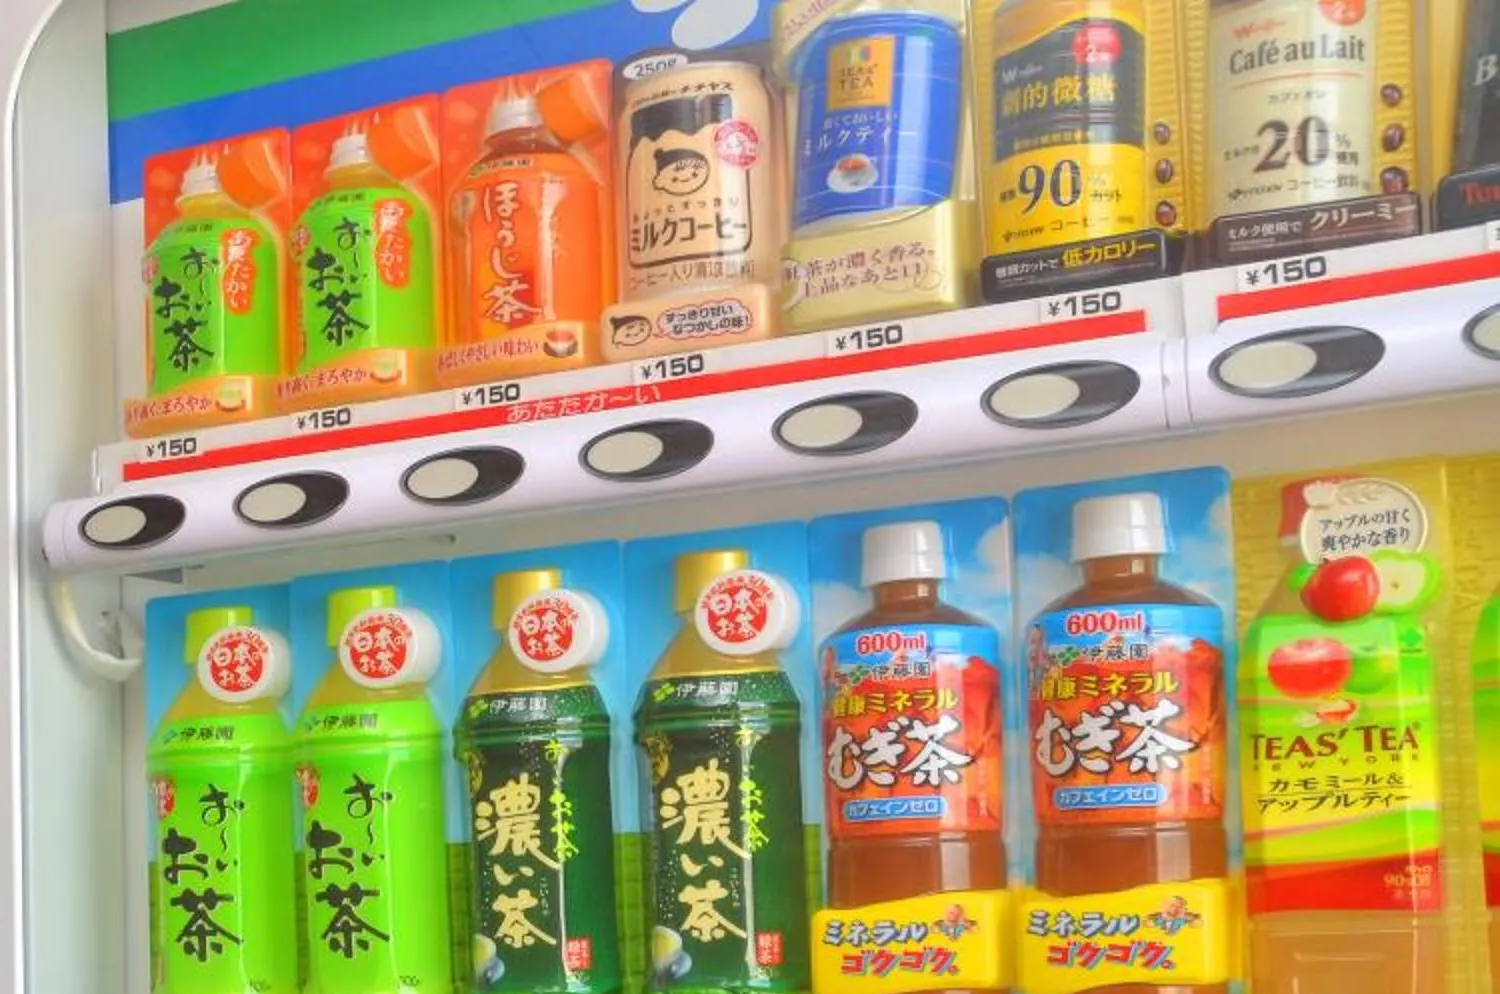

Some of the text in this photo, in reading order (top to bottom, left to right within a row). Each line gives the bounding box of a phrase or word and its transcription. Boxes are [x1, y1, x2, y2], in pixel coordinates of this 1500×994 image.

[1228, 33, 1366, 76] Café au Lait
[1253, 116, 1331, 175] 20
[1017, 158, 1082, 215] 90
[631, 211, 748, 252] ミルクコーヒー
[1310, 202, 1417, 232] クリーミー
[483, 179, 543, 324] ほうじ茶
[1061, 238, 1157, 269] 低カロリー
[1245, 256, 1328, 287] ¥150
[306, 246, 370, 347] お茶
[1048, 291, 1122, 317] ¥150
[154, 275, 215, 373] お茶
[835, 323, 904, 351] ¥150
[641, 354, 705, 380] ¥150
[462, 384, 522, 406] ¥150
[297, 408, 352, 430] ¥150
[146, 437, 198, 458] ¥150
[1318, 507, 1411, 531] アップルの甘く
[1320, 529, 1411, 551] 爽やかな香り
[1066, 610, 1144, 636] 600ml
[855, 630, 925, 656] 600ml
[1041, 671, 1180, 701] 健康ミネラル
[833, 686, 959, 719] 健康ミネラル
[827, 714, 973, 791] むぎ茶
[1033, 698, 1200, 779] むぎ茶
[1354, 725, 1420, 753] TEA
[846, 799, 940, 820] カフェインゼロ
[1057, 785, 1159, 808] カフェインゼロ
[1256, 793, 1412, 816] アップルティー
[475, 772, 562, 949] 濃い茶
[659, 757, 753, 943] 濃い茶
[163, 826, 244, 964] お茶
[307, 820, 391, 959] お茶
[823, 919, 929, 946] ミネラル
[1028, 910, 1141, 938] ミネラル
